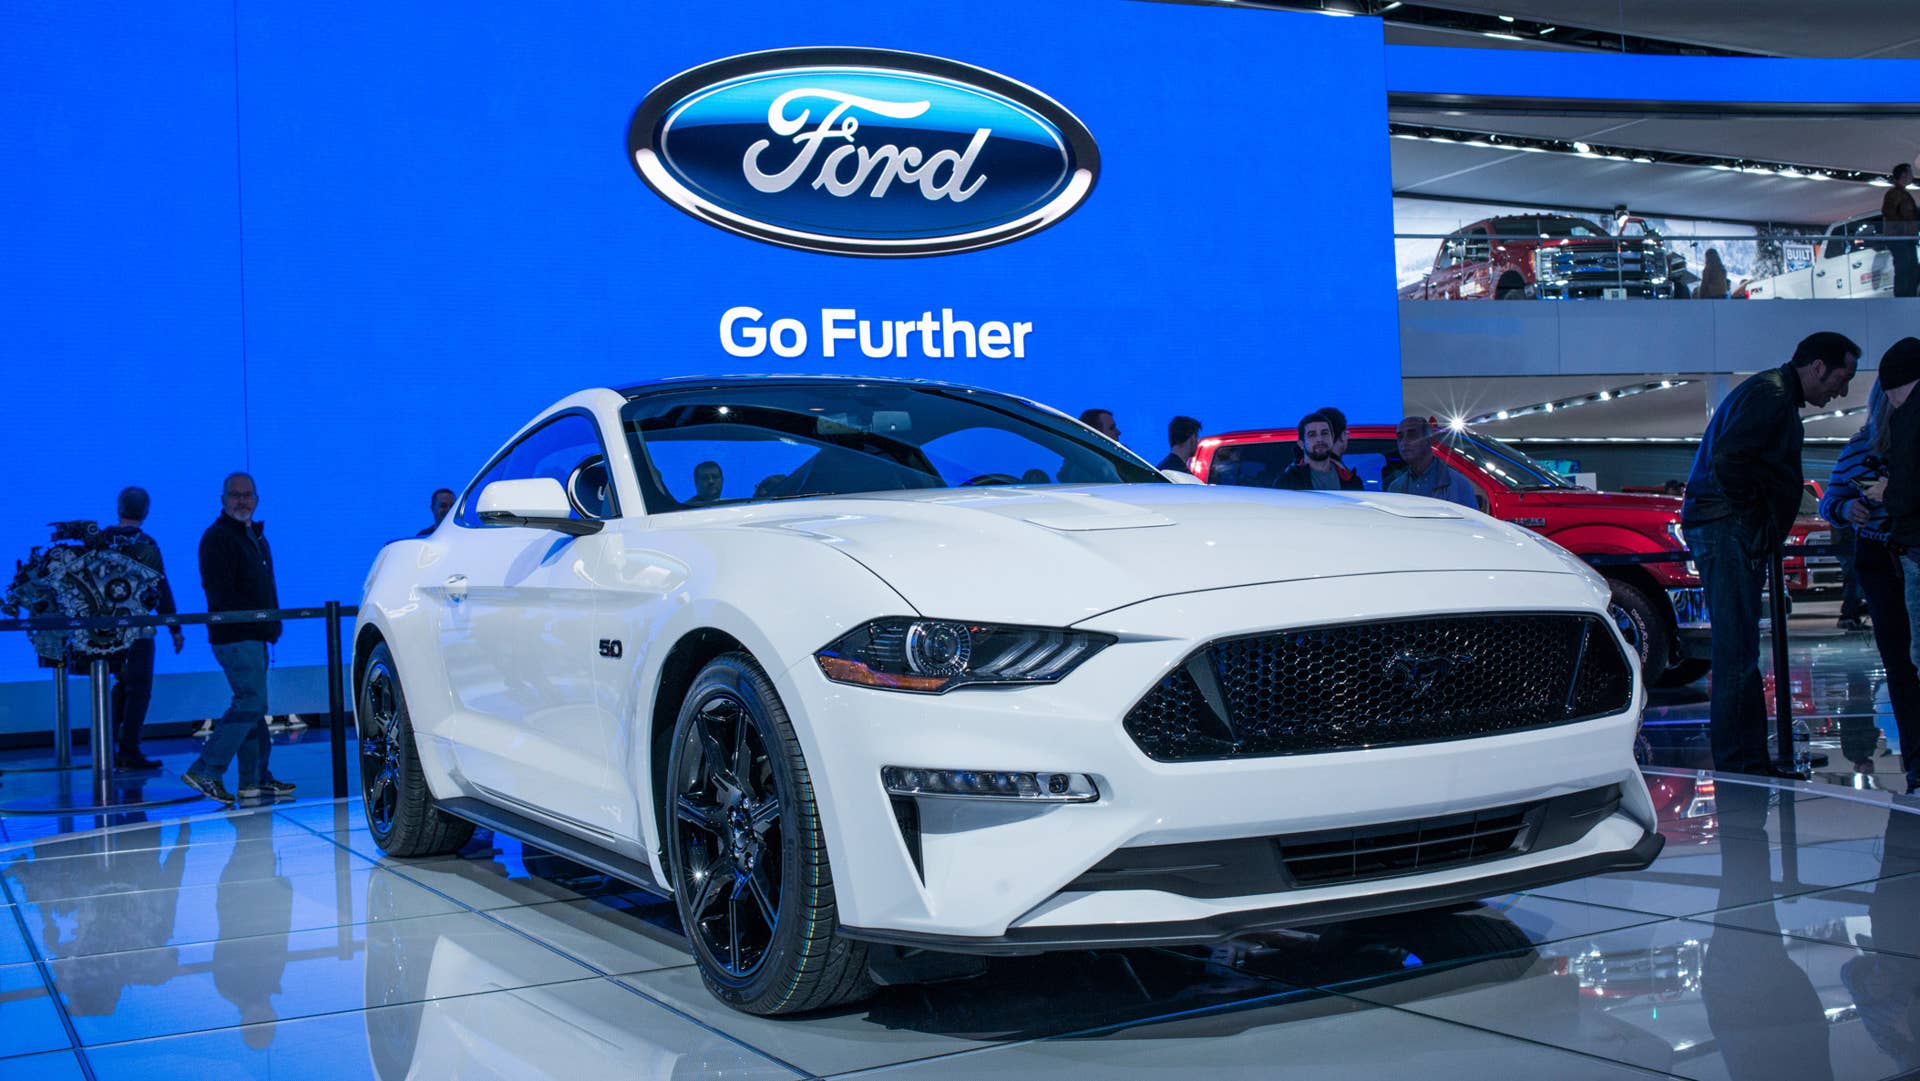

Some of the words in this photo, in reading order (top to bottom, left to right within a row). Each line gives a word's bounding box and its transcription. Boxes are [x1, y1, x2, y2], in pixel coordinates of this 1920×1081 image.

[742, 87, 992, 203] Ford
[1786, 248, 1810, 260] BUILT
[719, 306, 808, 358] Go
[821, 308, 1033, 359] Further
